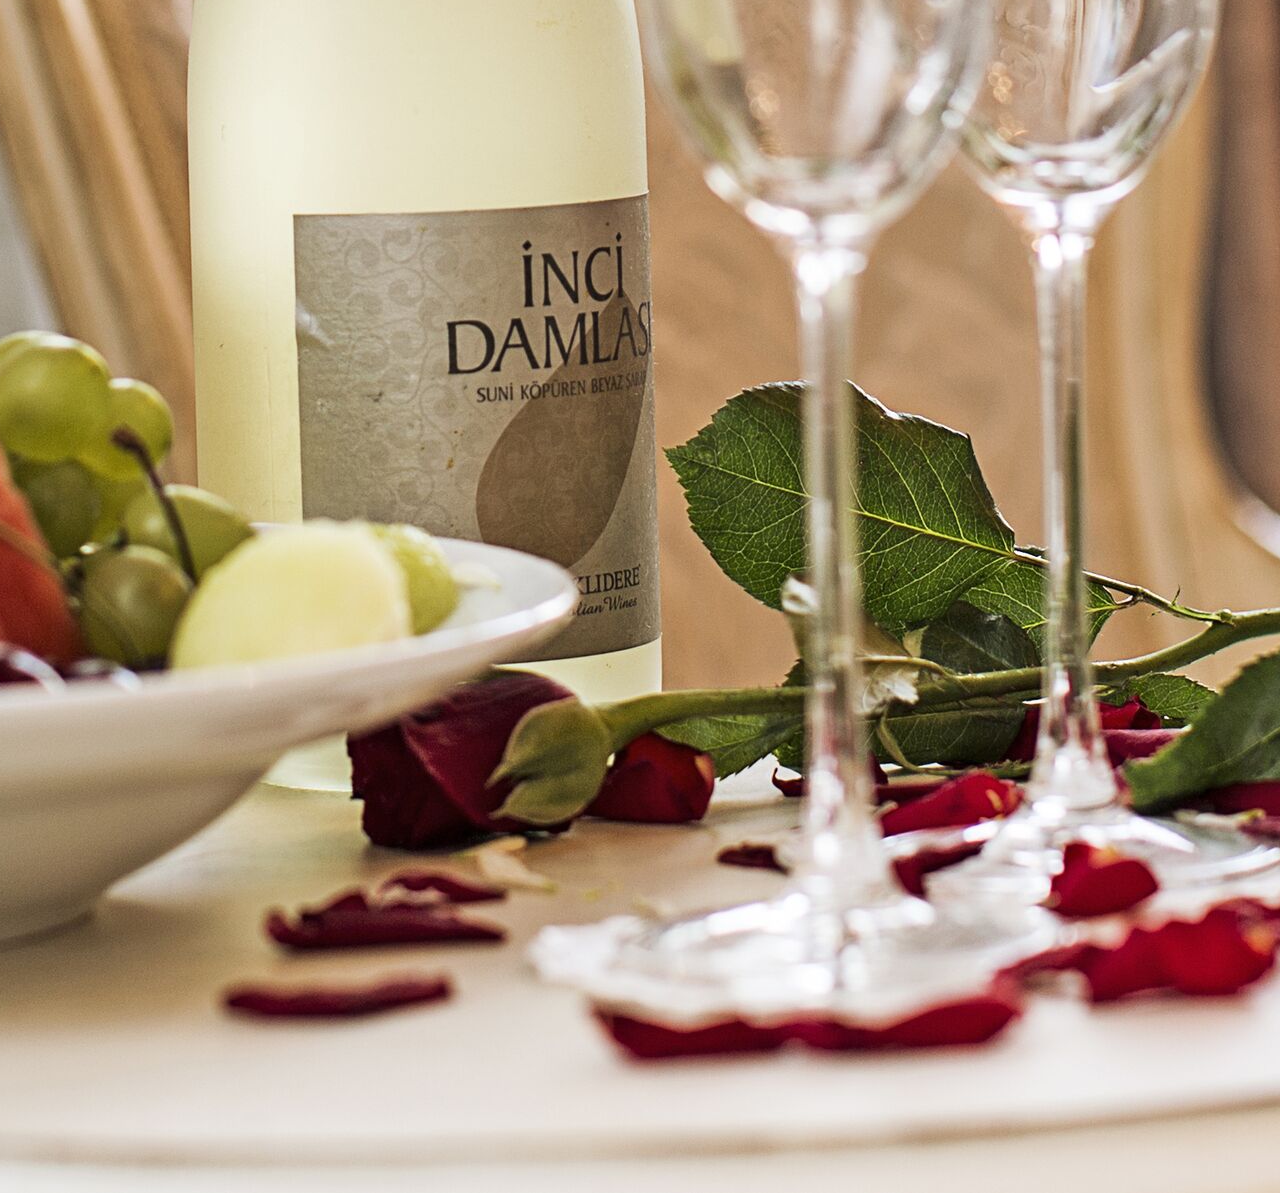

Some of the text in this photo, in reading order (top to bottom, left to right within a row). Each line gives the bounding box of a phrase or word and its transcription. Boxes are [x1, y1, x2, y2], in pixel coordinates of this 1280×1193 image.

[522, 231, 625, 308] İNCİ
[476, 382, 514, 404] SUNİ
[520, 379, 587, 400] KÖPÜREN
[591, 374, 624, 394] BEYAZ
[604, 594, 638, 611] Wines
